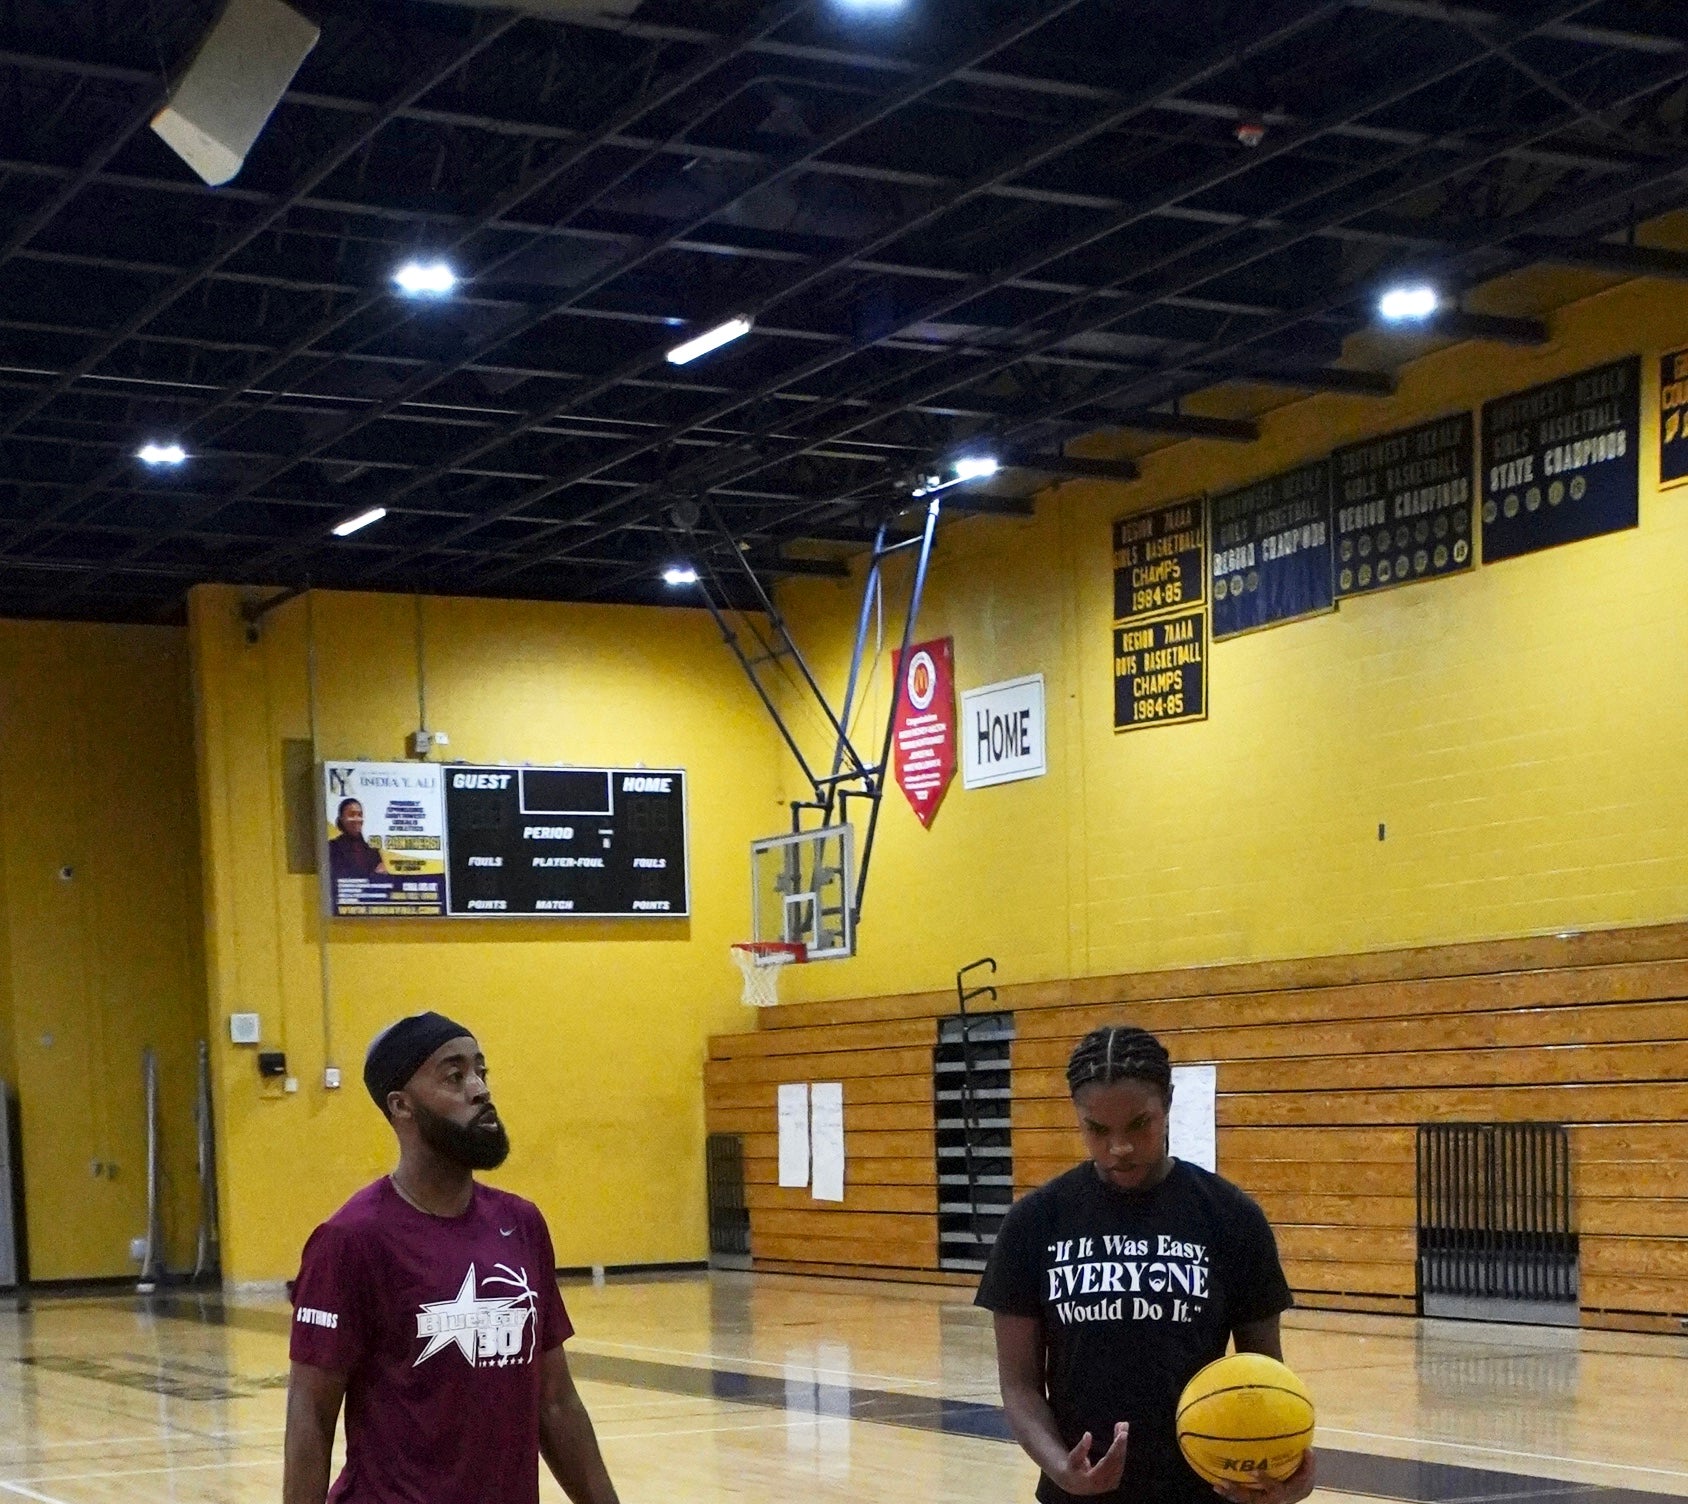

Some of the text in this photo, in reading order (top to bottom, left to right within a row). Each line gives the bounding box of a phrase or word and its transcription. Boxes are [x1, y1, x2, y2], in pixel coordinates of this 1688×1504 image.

[1490, 455, 1534, 492] STATE
[1543, 429, 1627, 476] CHAMPIONS
[1394, 477, 1468, 518] CHAMPIONS
[1132, 558, 1181, 588] CHAMPS
[1122, 628, 1154, 653] REGION
[1115, 642, 1201, 677] BOYS BASKETBALL
[1133, 669, 1183, 697] CHAMPS
[453, 773, 511, 789] GUEST
[622, 777, 673, 792] HOME
[523, 826, 574, 839] PERIOD
[468, 856, 503, 867] FOULS
[532, 857, 605, 868] PLAYER-FOUL
[633, 858, 667, 868] FOULS
[467, 900, 507, 910] POINTS
[535, 900, 574, 910] MATCH
[632, 901, 671, 910] POINTS
[1077, 1237, 1093, 1258] It
[1102, 1235, 1149, 1256] Was
[1056, 1298, 1123, 1325] Would
[1132, 1297, 1163, 1320] Do
[478, 1327, 522, 1358] 30
